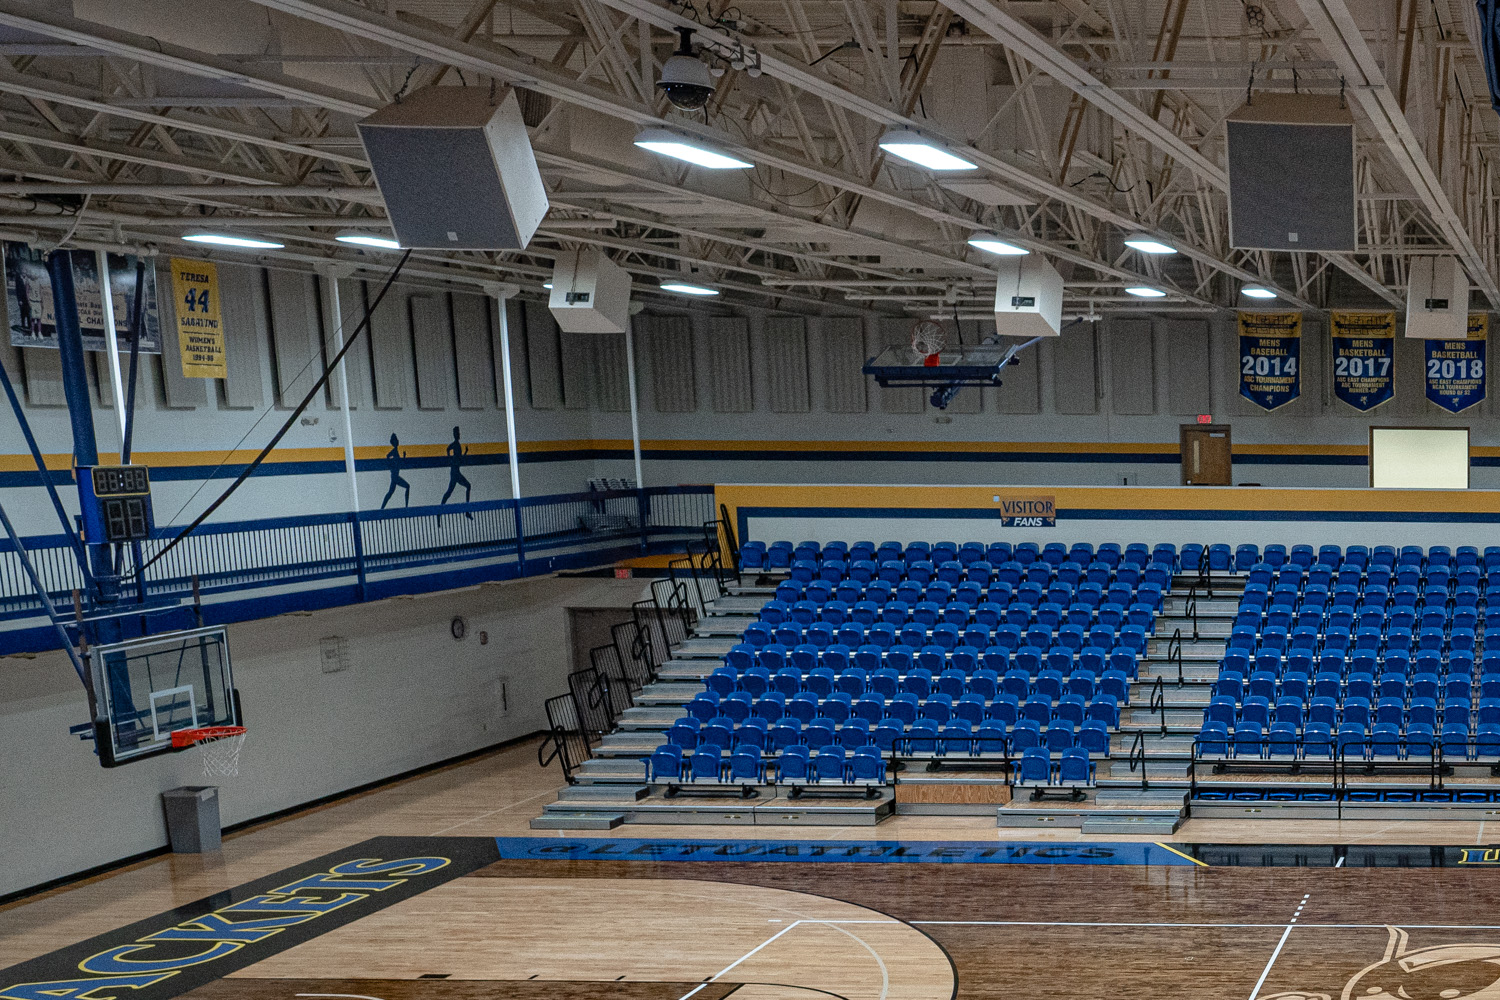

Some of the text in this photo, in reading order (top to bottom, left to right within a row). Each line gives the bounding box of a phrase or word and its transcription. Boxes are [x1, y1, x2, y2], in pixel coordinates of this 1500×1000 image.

[180, 272, 209, 283] TERESA
[184, 288, 209, 313] 44
[1259, 339, 1280, 347] MENS
[1445, 342, 1466, 350] MENS
[185, 345, 222, 354] BASKETBALL
[1339, 349, 1386, 357] BASKETBALL
[1242, 356, 1297, 376] 2014
[1336, 357, 1390, 376] 2017
[1428, 359, 1483, 378] 2018
[1256, 376, 1295, 384] TOURNAMENT
[1250, 384, 1289, 392] CHAMPIONS
[1002, 501, 1053, 514] VISITOR
[1014, 517, 1043, 526] FANS
